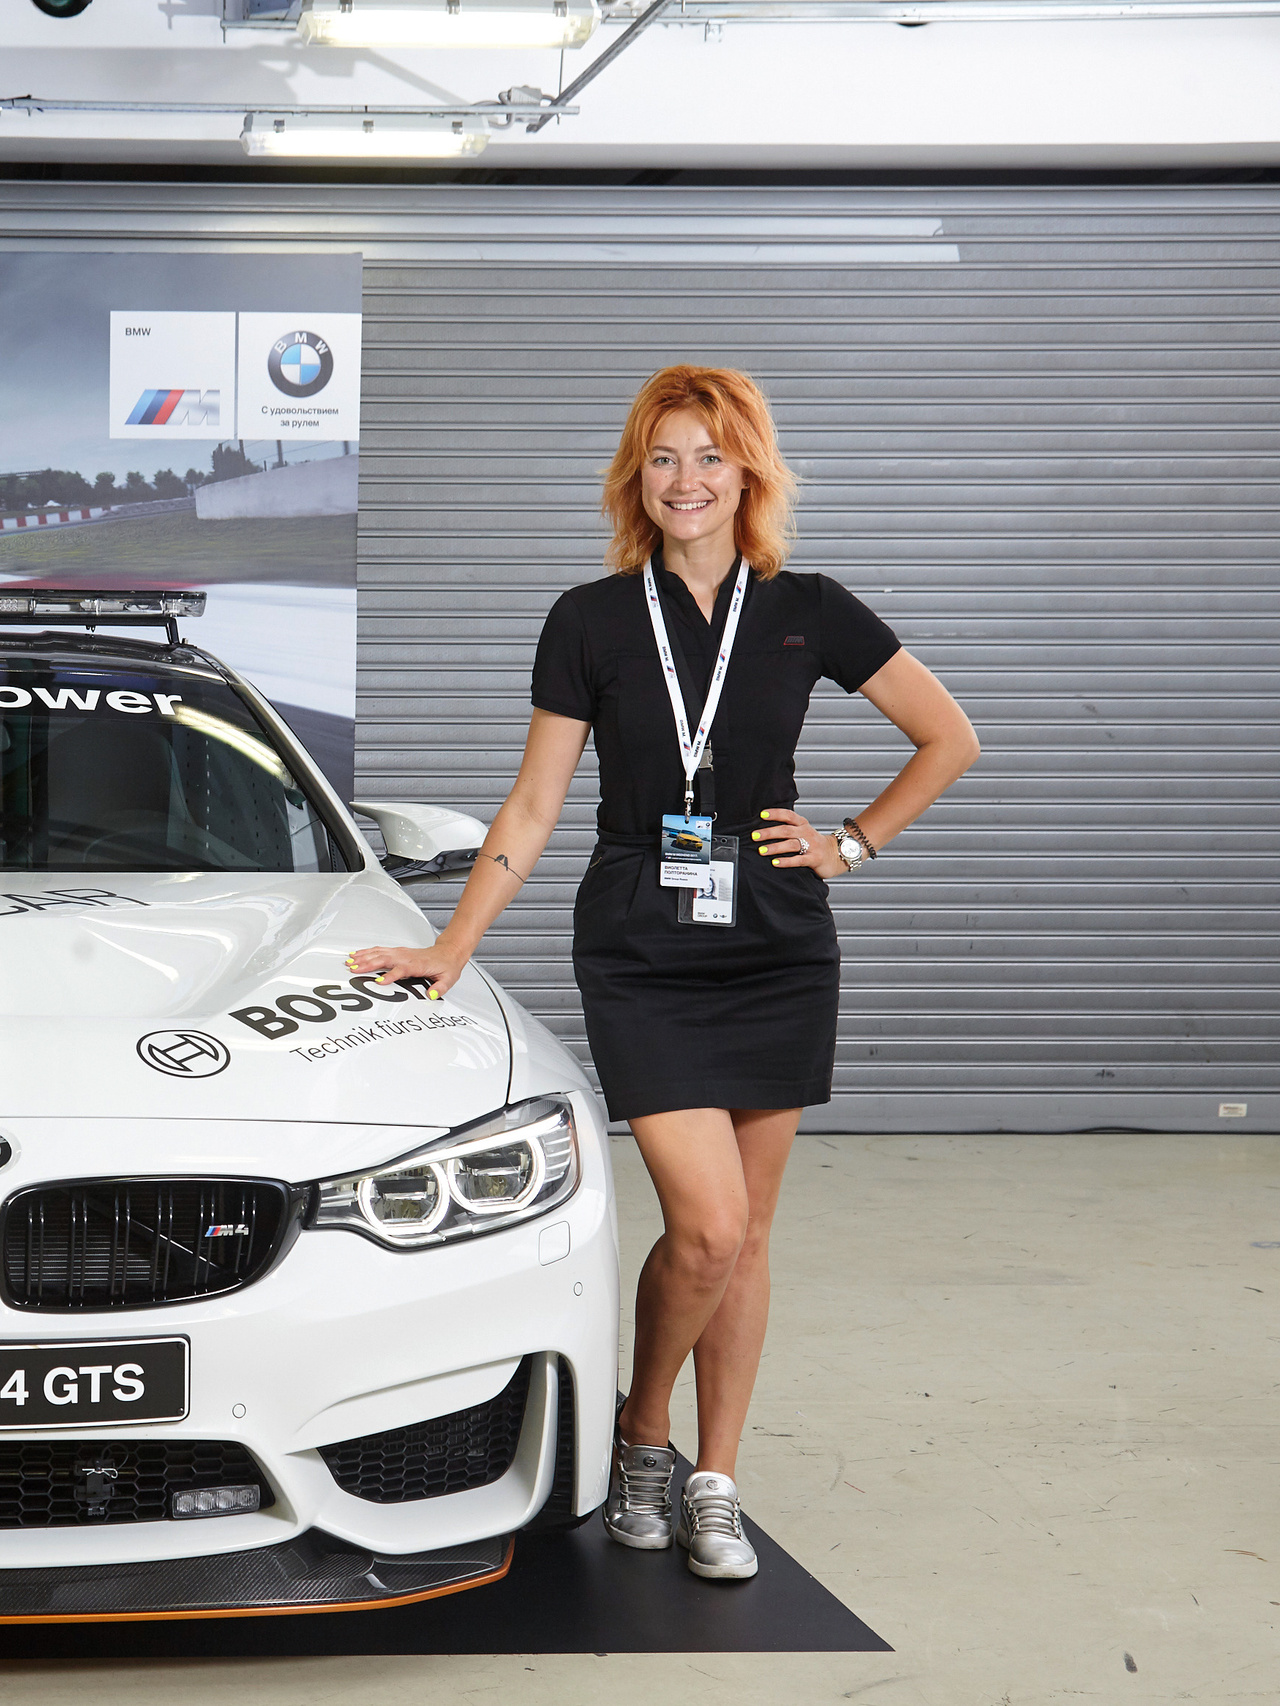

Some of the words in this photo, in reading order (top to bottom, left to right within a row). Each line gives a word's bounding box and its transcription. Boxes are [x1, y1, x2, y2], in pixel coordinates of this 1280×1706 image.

[124, 327, 152, 336] BMW
[274, 332, 329, 355] BMW
[261, 406, 269, 415] С
[270, 407, 340, 417] удовольствием
[291, 420, 321, 429] рулем
[289, 1025, 384, 1063] Technik
[374, 1019, 423, 1037] fürs
[413, 1012, 479, 1032] Leben
[42, 1362, 146, 1405] GTS
